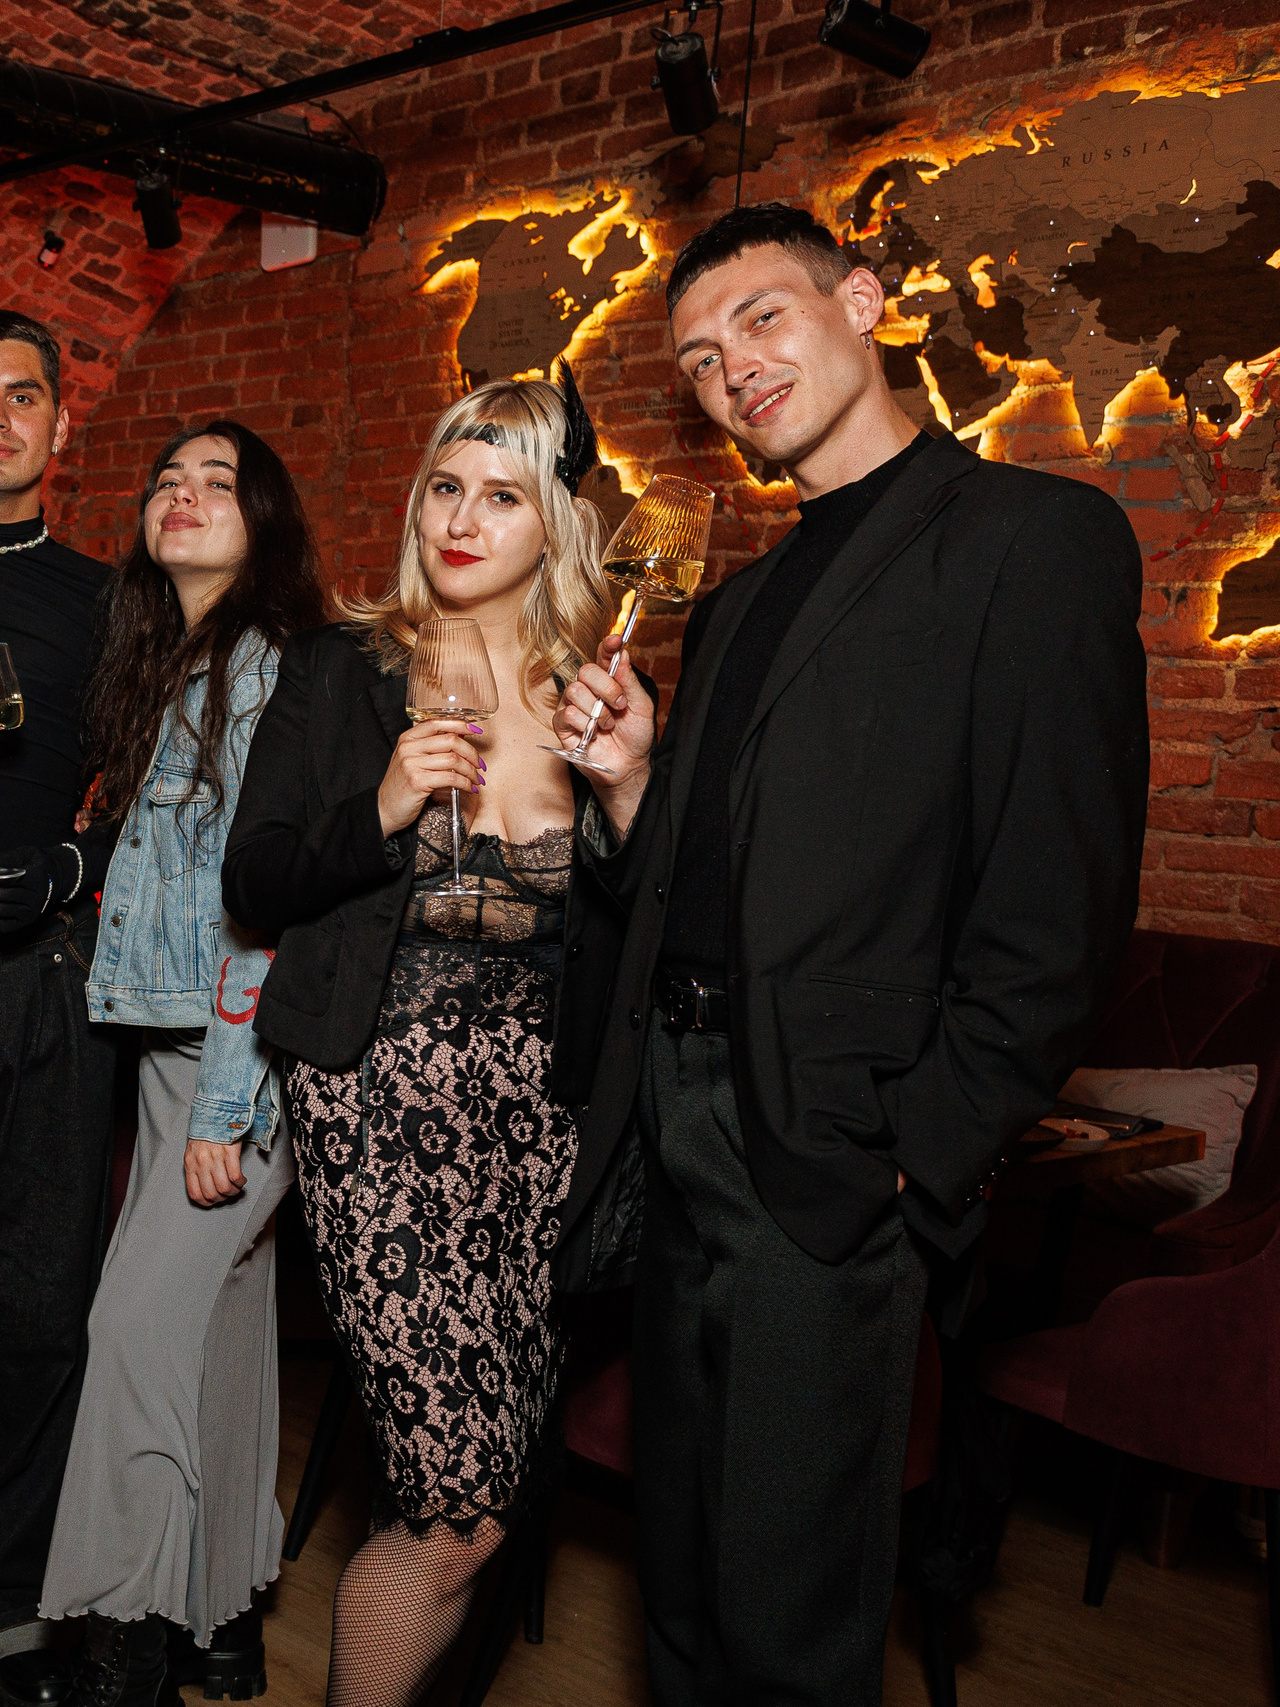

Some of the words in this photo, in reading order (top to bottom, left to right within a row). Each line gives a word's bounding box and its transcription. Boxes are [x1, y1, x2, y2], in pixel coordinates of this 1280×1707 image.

[1061, 138, 1170, 168] RUSSIA
[502, 254, 548, 269] CANADA
[1089, 367, 1120, 377] INDIA
